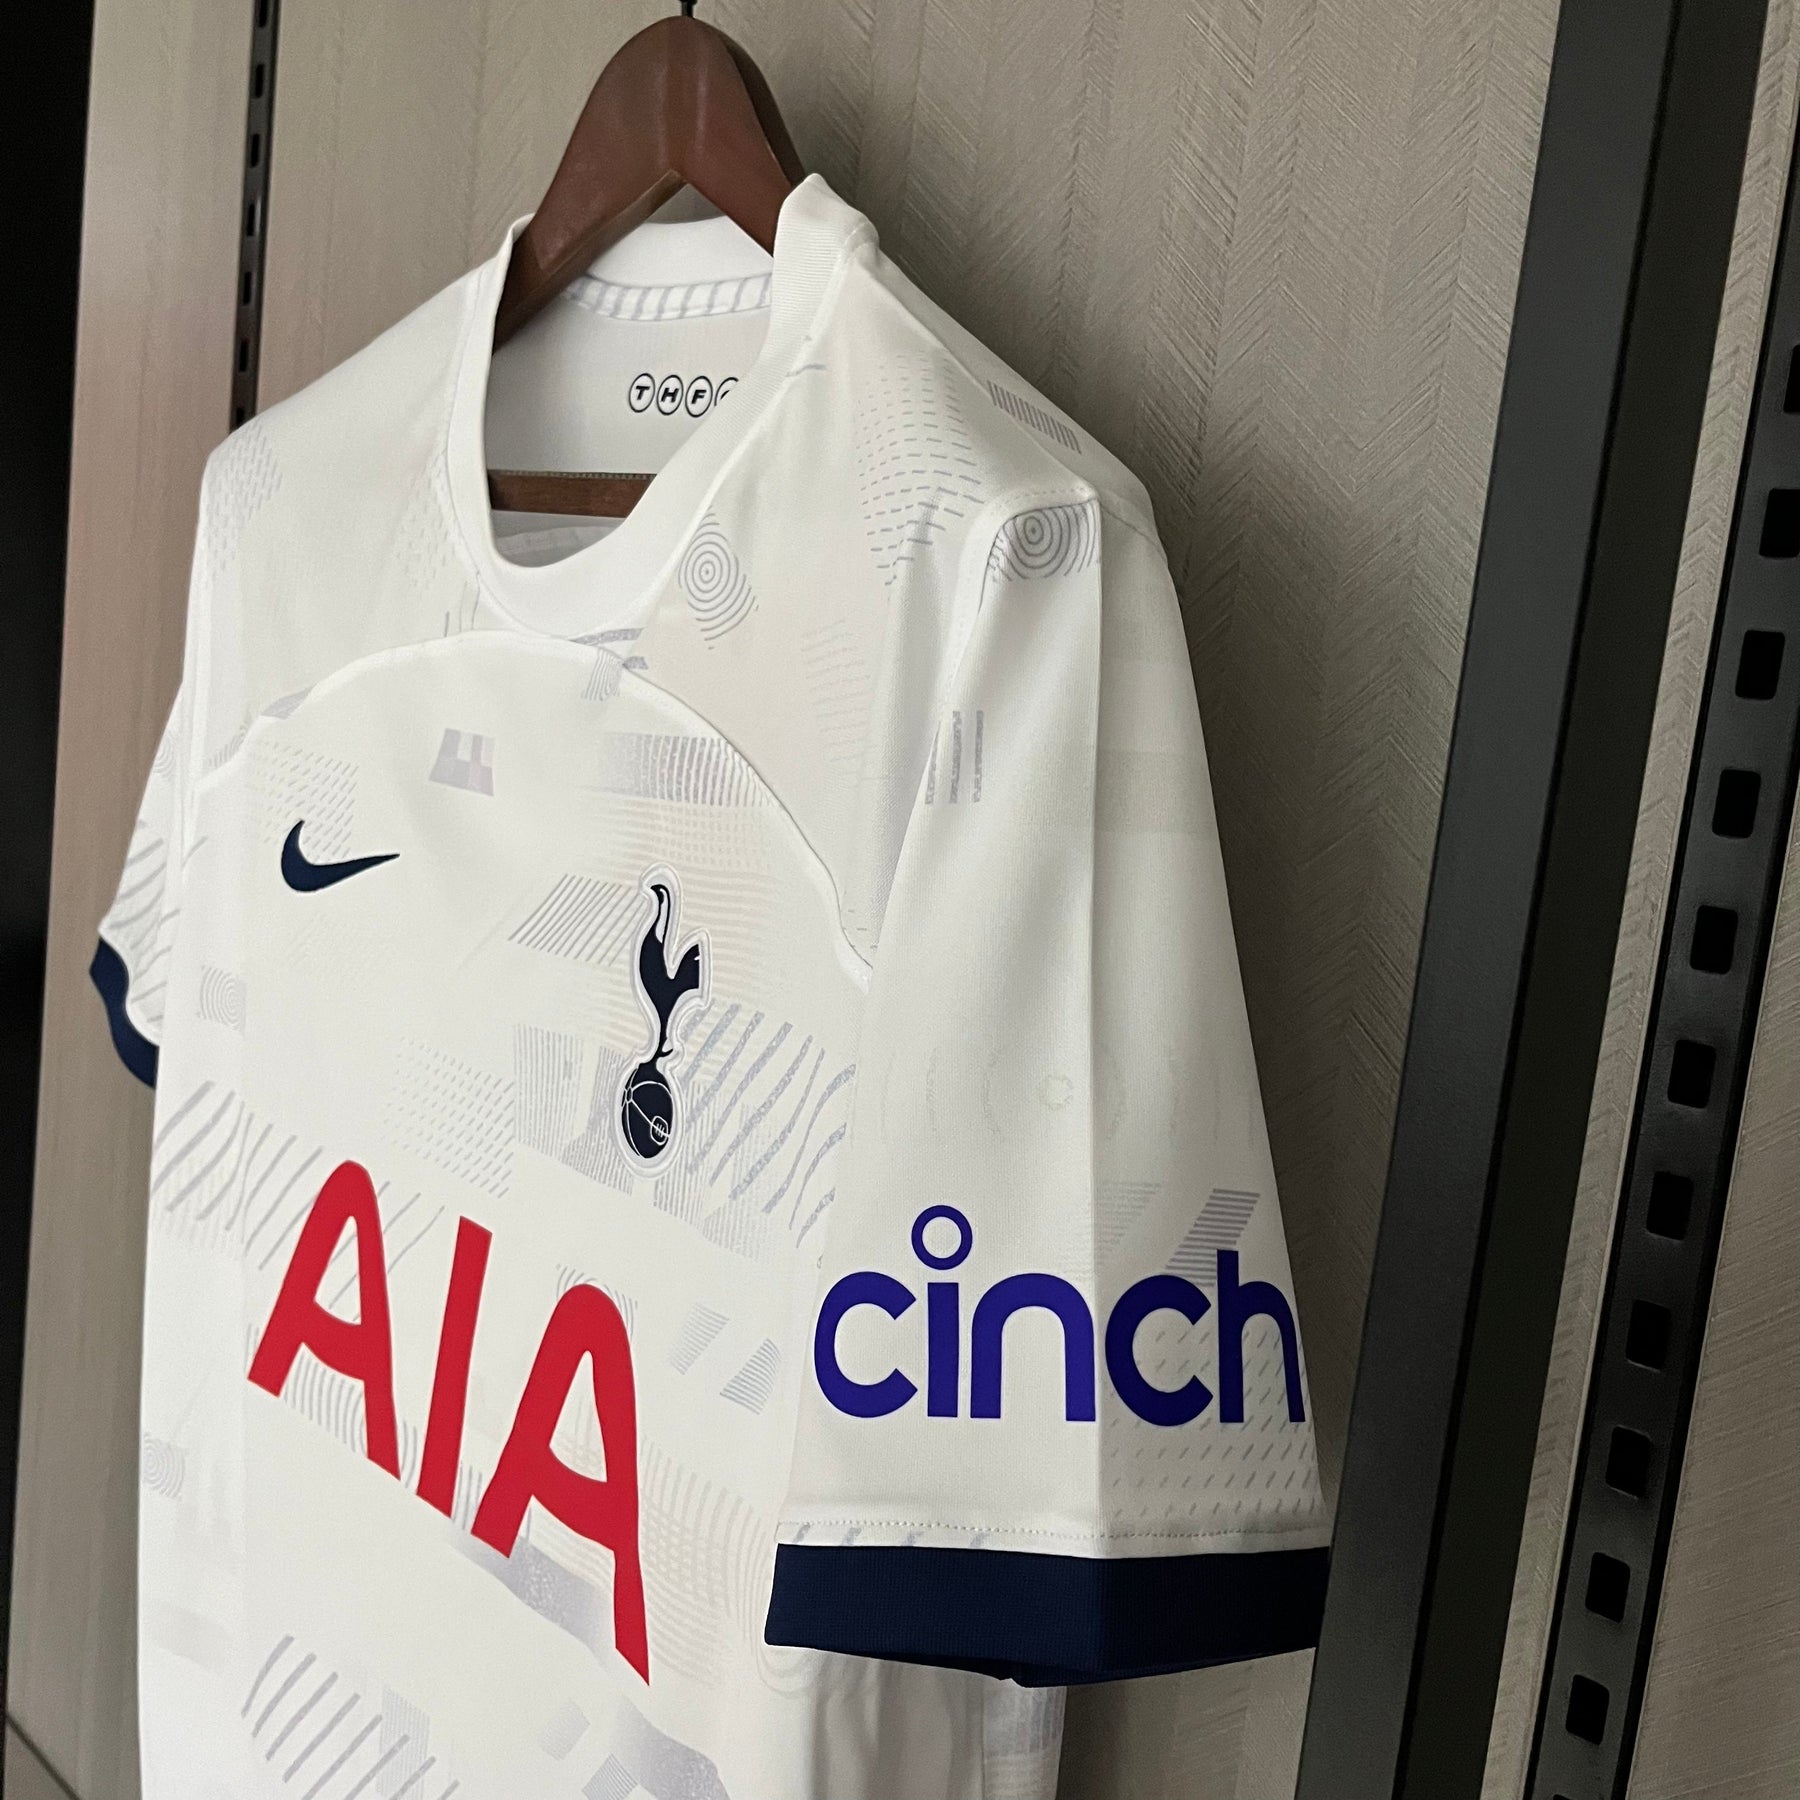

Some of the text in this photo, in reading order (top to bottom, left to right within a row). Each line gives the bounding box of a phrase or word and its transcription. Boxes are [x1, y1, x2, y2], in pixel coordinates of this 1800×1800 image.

[629, 373, 738, 418] THF
[247, 1160, 650, 1686] AIA
[814, 1205, 1306, 1427] cinch
